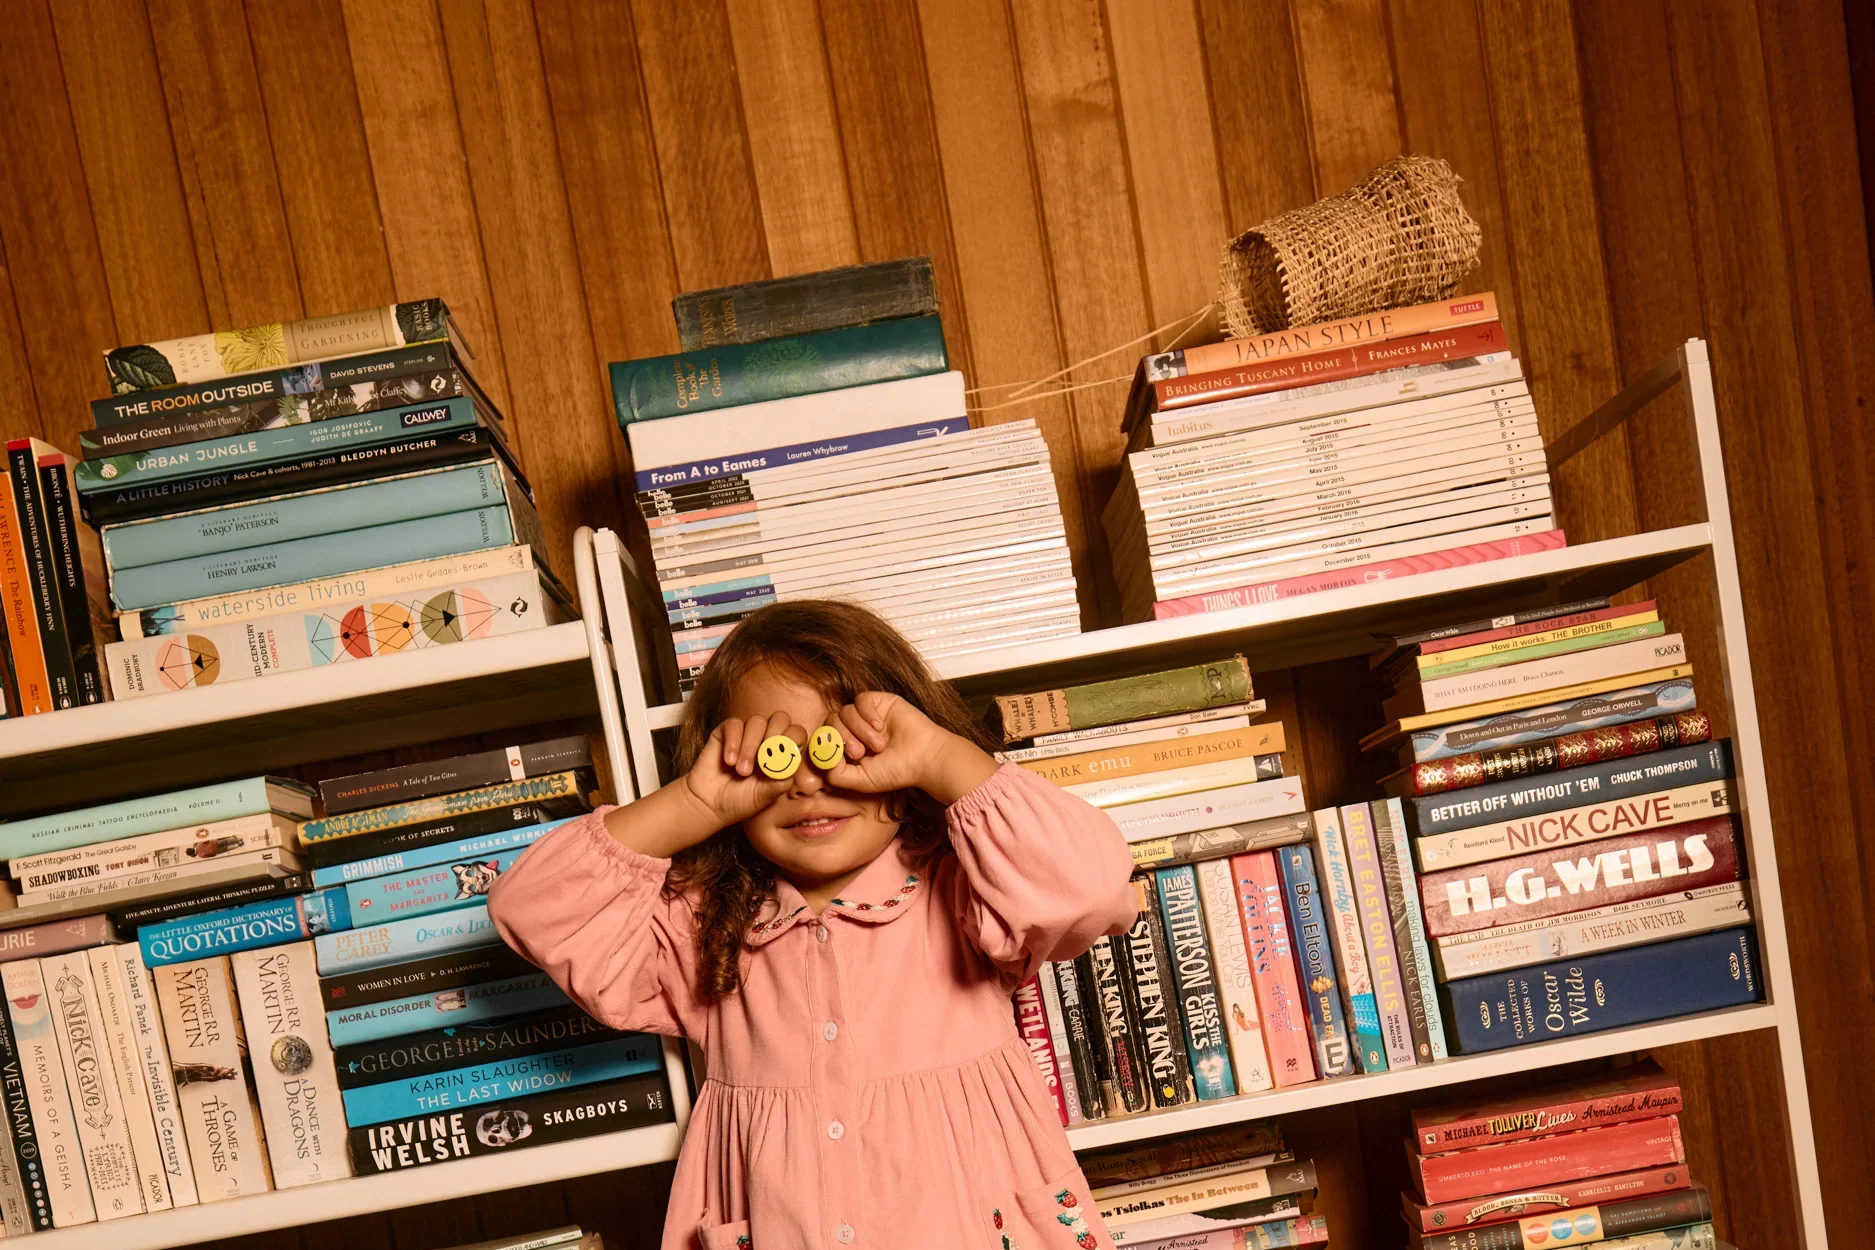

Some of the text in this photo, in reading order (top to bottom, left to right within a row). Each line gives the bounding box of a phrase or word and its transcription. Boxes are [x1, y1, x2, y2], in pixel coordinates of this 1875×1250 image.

[1453, 303, 1480, 314] TUTTLE
[1234, 315, 1394, 363] JAPAN STYLE
[330, 362, 395, 379] DAVID STEVENS
[1164, 357, 1342, 397] BRINGING TUSCANY HOME
[114, 381, 274, 419] THE ROOM OUTSIDE
[103, 414, 241, 446] Indoor Green Living Plants
[404, 409, 447, 425] CALLWEY
[1167, 419, 1213, 435] habitus
[136, 441, 257, 471] URBAN JUNGLE
[341, 440, 437, 462] BLEDDYN BUTCHER
[651, 456, 767, 484] From A to Eames
[207, 561, 276, 579] HENRY LAWSON
[198, 578, 366, 620] waterside living
[1655, 644, 1681, 658] PICADOR
[1581, 700, 1642, 717] GEORGE ORWELL
[1153, 738, 1244, 761] BRUCE PASCOE
[1089, 754, 1132, 774] emu
[1610, 758, 1698, 784] CHUCK THOMPSON
[337, 781, 399, 798] CHARLES DICKENS
[1431, 782, 1572, 822] BETTER OFF WITHOUT
[1506, 796, 1673, 850] NICK CAVE
[28, 864, 100, 888] SHADOWBOXING
[342, 855, 403, 879] GRIMMISH
[1163, 873, 1192, 892] JAMES
[390, 892, 449, 912] MARGARITA
[189, 906, 285, 933] OXFORD DICTIONARY
[1295, 881, 1324, 976] Ben Elton
[150, 914, 296, 960] QUOTATIONS
[357, 971, 426, 991] WOMEN LOVE
[173, 970, 204, 1049] MARTIN
[338, 1000, 431, 1025] MORAL DISORDER
[1545, 966, 1591, 1032] Oscar Wilde
[410, 1053, 575, 1094] KARIN SLAUGHTER
[2, 1060, 31, 1139] VIETNAM
[417, 1070, 573, 1109] THE LAST WIDOW
[32, 1045, 72, 1192] MEMOIRS GEISHA
[283, 1080, 311, 1160] DRAGONS
[543, 1099, 628, 1126] SKAGBOYS
[201, 1100, 228, 1173] THRONES
[368, 1113, 466, 1149] IRVINE
[1444, 1113, 1536, 1141] MICHAEL TOLLIVER
[371, 1135, 470, 1171] WELSH
[149, 1174, 162, 1204] PICADOR
[1203, 1180, 1259, 1200] Between
